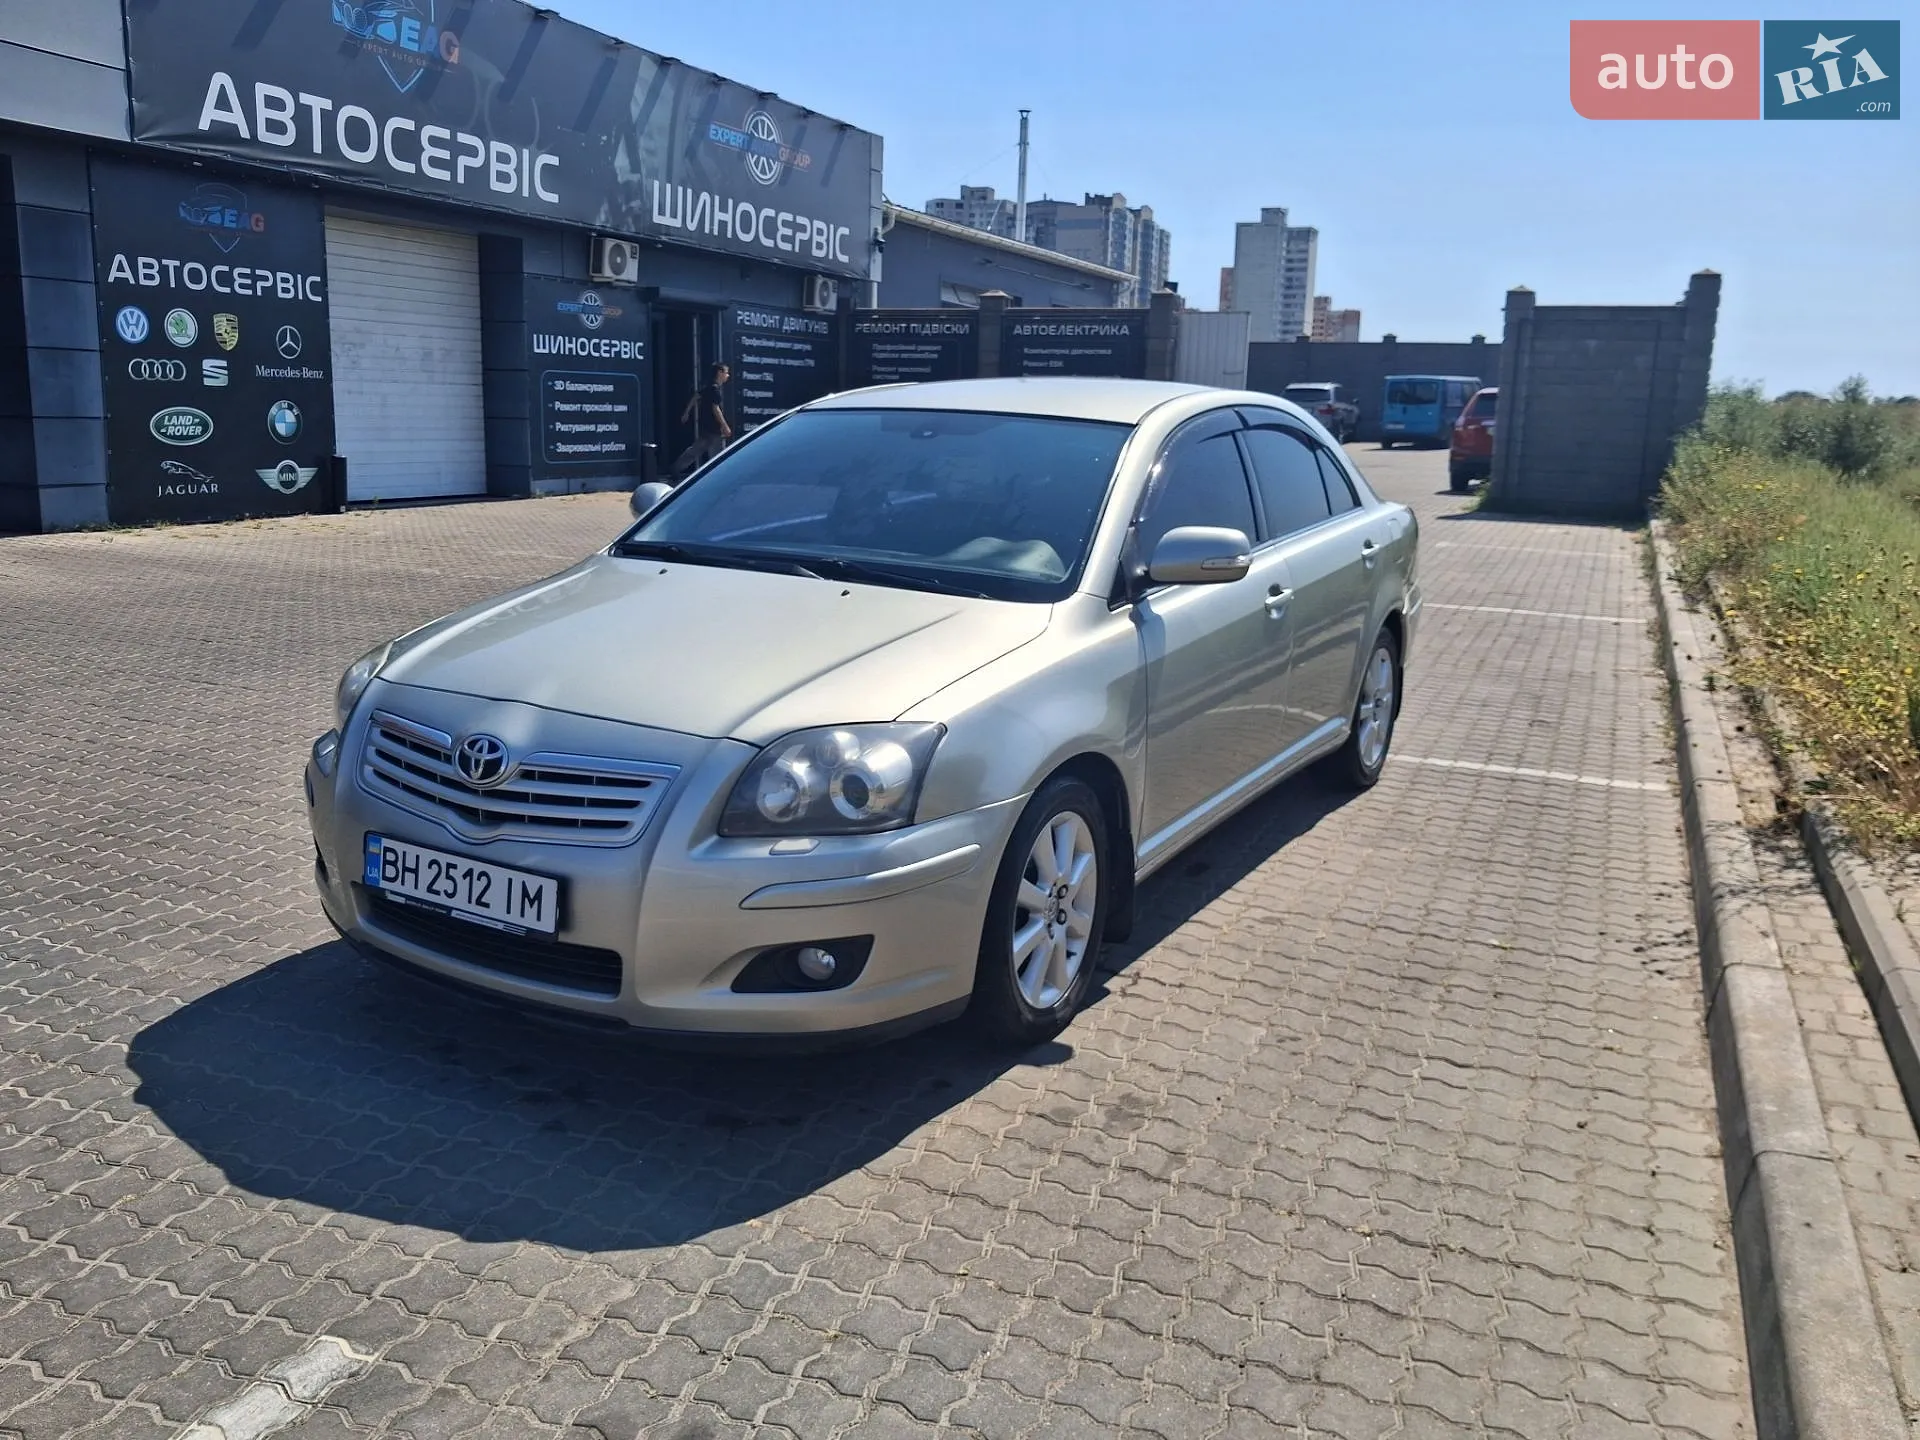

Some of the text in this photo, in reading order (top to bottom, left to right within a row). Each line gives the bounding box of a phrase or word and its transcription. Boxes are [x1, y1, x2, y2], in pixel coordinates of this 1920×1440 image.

[400, 16, 460, 65] EAG
[198, 71, 560, 204] АВТОСЕРВІС
[652, 179, 850, 264] ШИНОСЕРВІС
[107, 253, 323, 302] АВТОСЕРВІС
[736, 310, 781, 329] РЕМОНТ
[854, 323, 970, 336] РЕМОНТ ПІДВІСКИ
[1013, 324, 1130, 336] АВТОЕЛЕКТРИКА
[533, 333, 645, 360] ШИНОСЕРВІС
[255, 364, 325, 380] Mercedes-Benz
[163, 415, 194, 426] LAND
[167, 426, 203, 437] ROVER
[157, 483, 220, 498] JAGUAR
[381, 846, 420, 890] BH
[425, 858, 492, 909] 2512
[505, 877, 544, 922] IM
